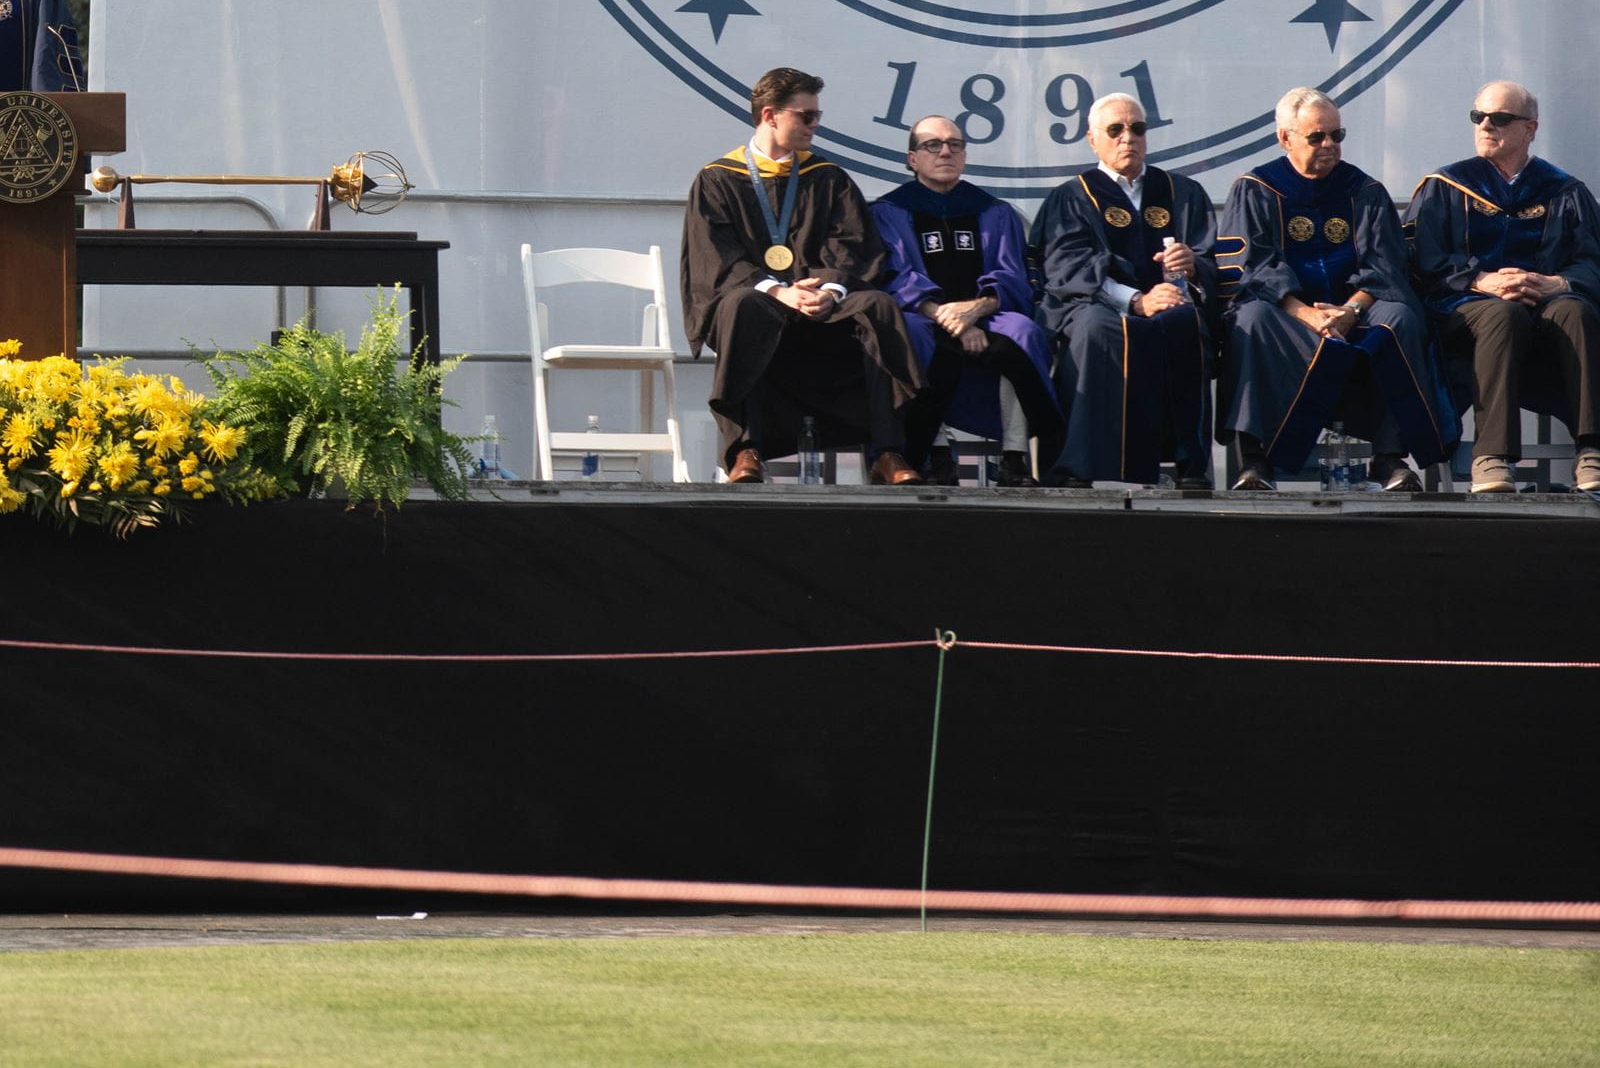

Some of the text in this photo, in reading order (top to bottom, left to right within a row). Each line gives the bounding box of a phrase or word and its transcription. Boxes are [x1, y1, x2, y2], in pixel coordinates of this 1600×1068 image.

[6, 95, 73, 170] UNIVERSITY
[872, 59, 1174, 145] 1891
[9, 188, 39, 198] 1891
